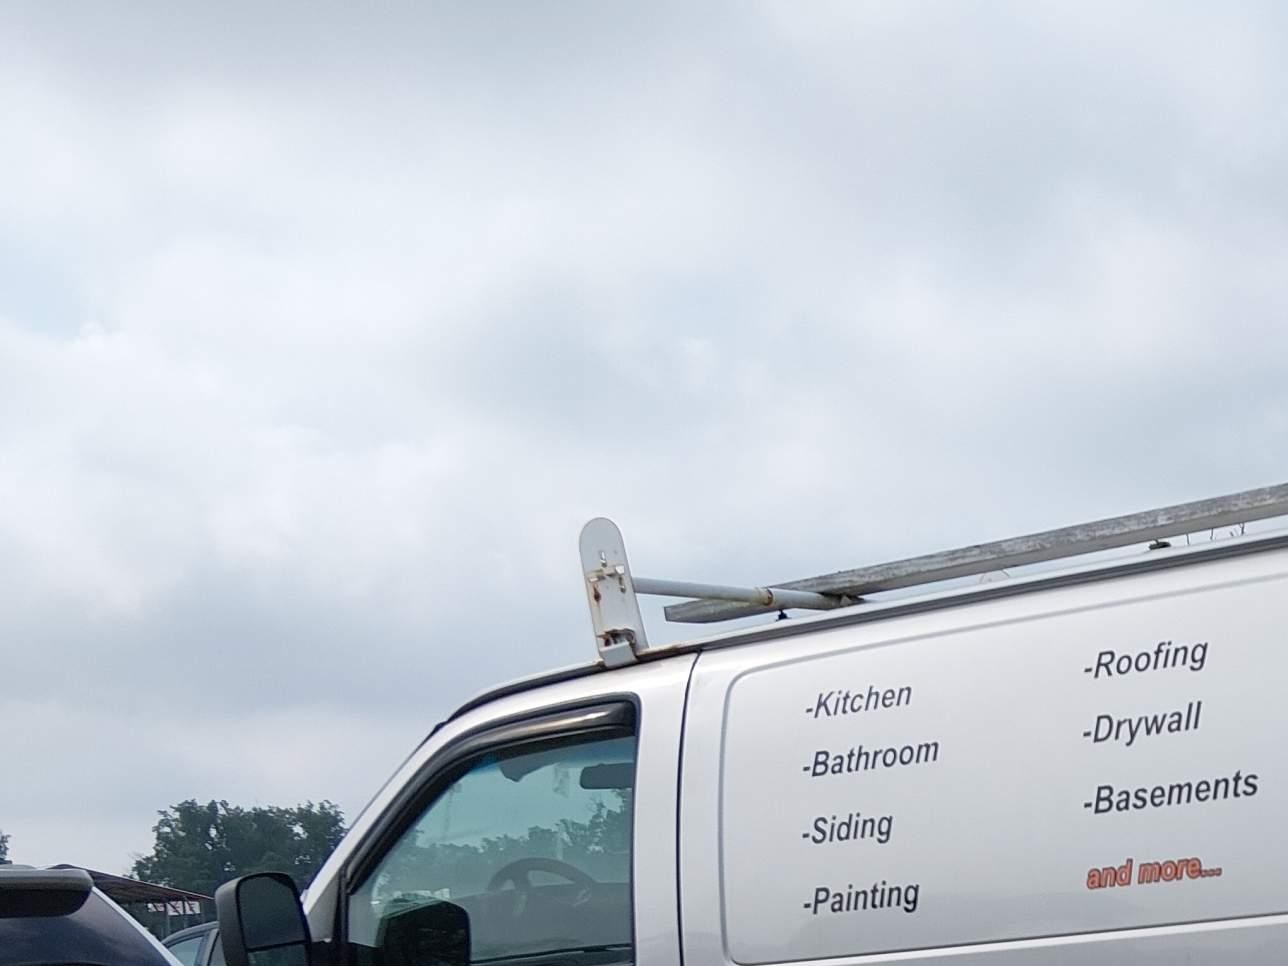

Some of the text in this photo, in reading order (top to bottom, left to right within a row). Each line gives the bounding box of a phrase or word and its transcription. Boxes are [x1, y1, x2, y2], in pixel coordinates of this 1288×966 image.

[1083, 640, 1209, 680] -Roofing
[804, 684, 913, 719] -Kitchen
[1083, 700, 1203, 747] -Drywall
[803, 740, 940, 778] -Bathroom
[1083, 769, 1259, 815] -Basements
[802, 811, 894, 845] -Siding
[1086, 855, 1224, 891] and more...
[803, 880, 921, 916] -Painting
